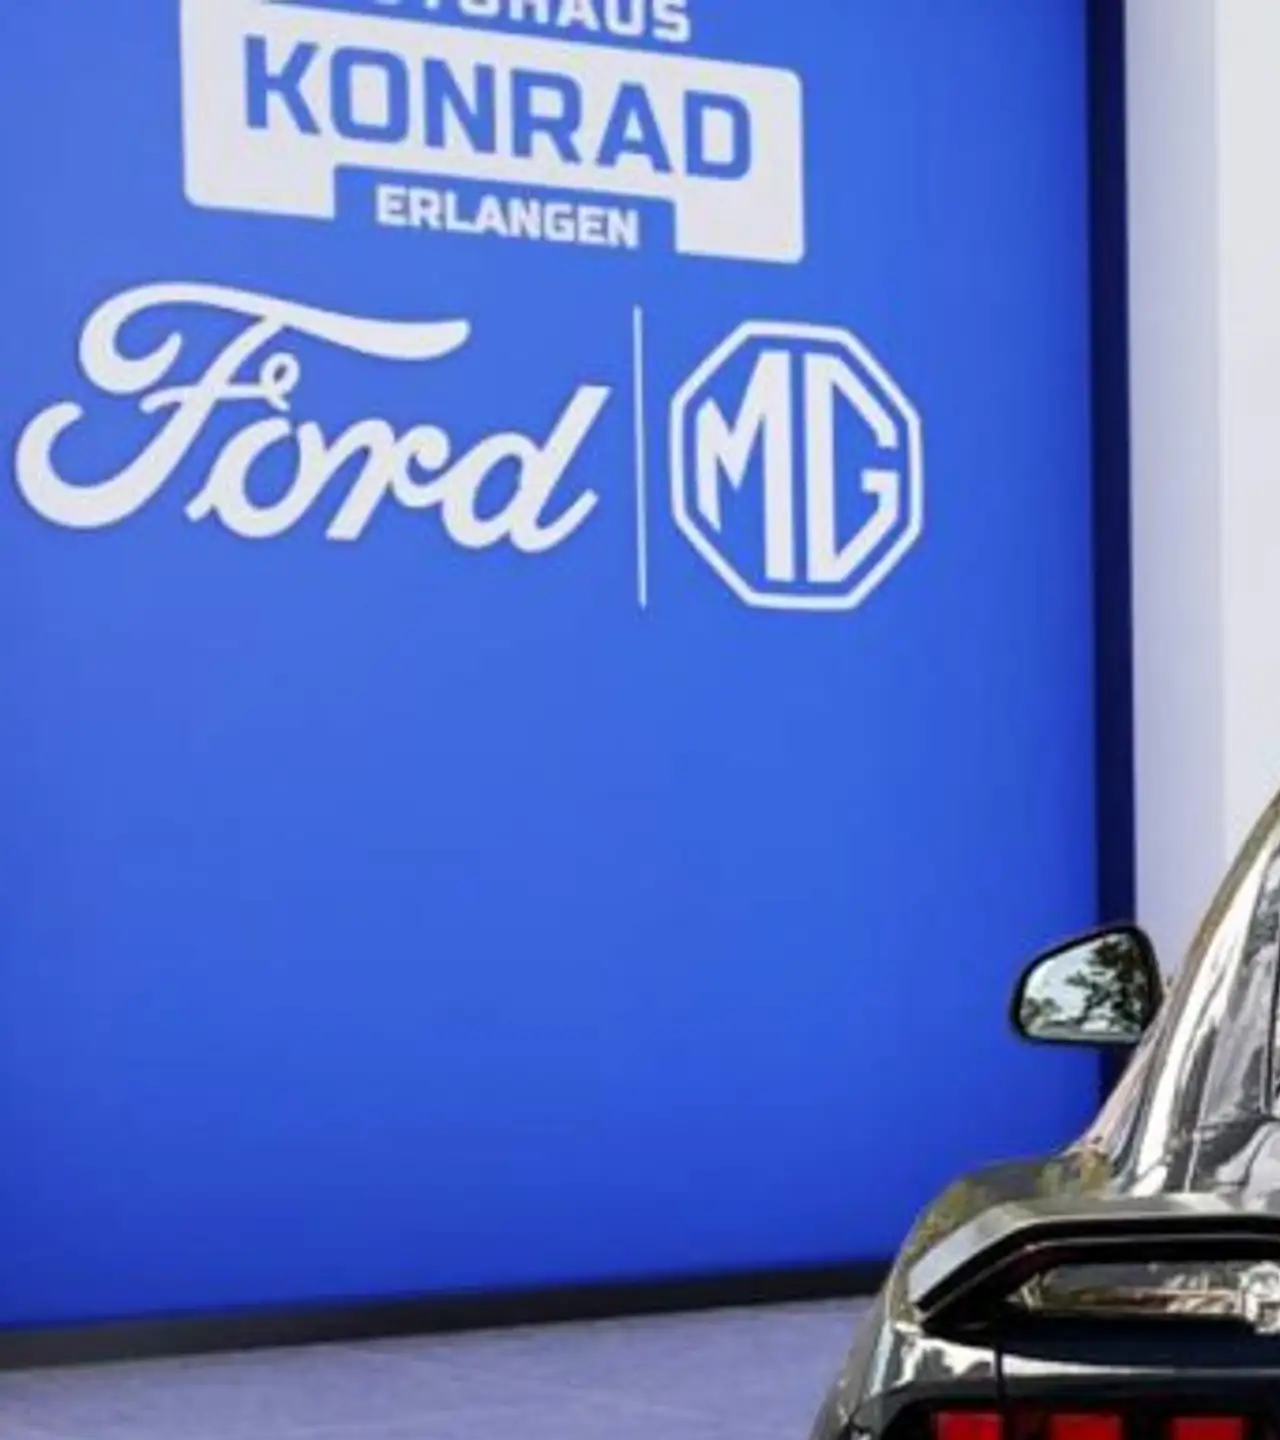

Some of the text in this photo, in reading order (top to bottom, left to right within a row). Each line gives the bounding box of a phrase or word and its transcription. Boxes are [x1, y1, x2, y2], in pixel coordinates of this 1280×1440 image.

[244, 34, 752, 181] KONRAD
[376, 184, 640, 249] ERLANGEN
[15, 282, 609, 552] Ford
[693, 349, 900, 584] MG
